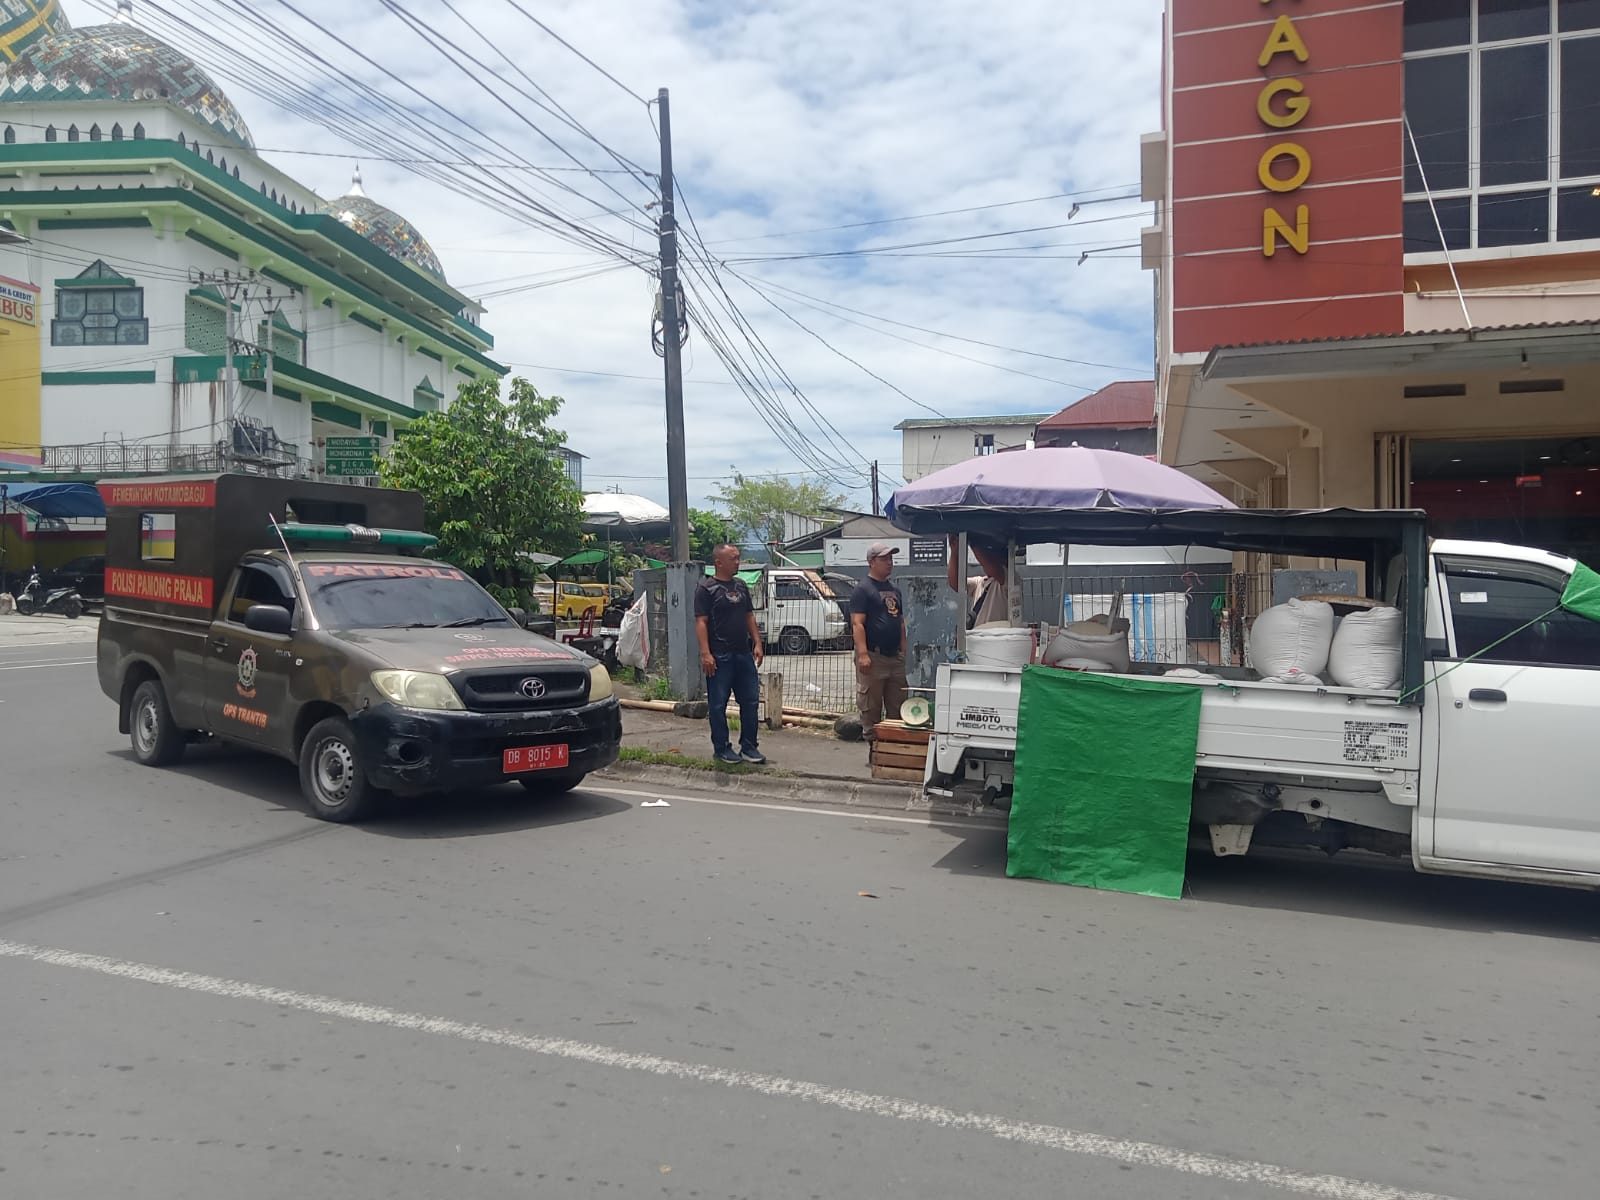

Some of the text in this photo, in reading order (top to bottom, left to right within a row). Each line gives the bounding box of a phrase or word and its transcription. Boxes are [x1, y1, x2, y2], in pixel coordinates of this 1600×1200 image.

[1257, 0, 1311, 257] AGON
[13, 290, 32, 301] CREDIT
[0, 297, 33, 321] BUS
[113, 486, 206, 502] PEMERINTAH KOTAMOBAGU
[308, 565, 464, 581] PATROLI
[111, 571, 203, 603] POLISI PAMONG PRAJA
[223, 703, 237, 720] OPS
[960, 713, 1000, 723] LIMBOTO
[957, 721, 1017, 732] MEGA CARR
[508, 746, 565, 764] DB 8015 K
